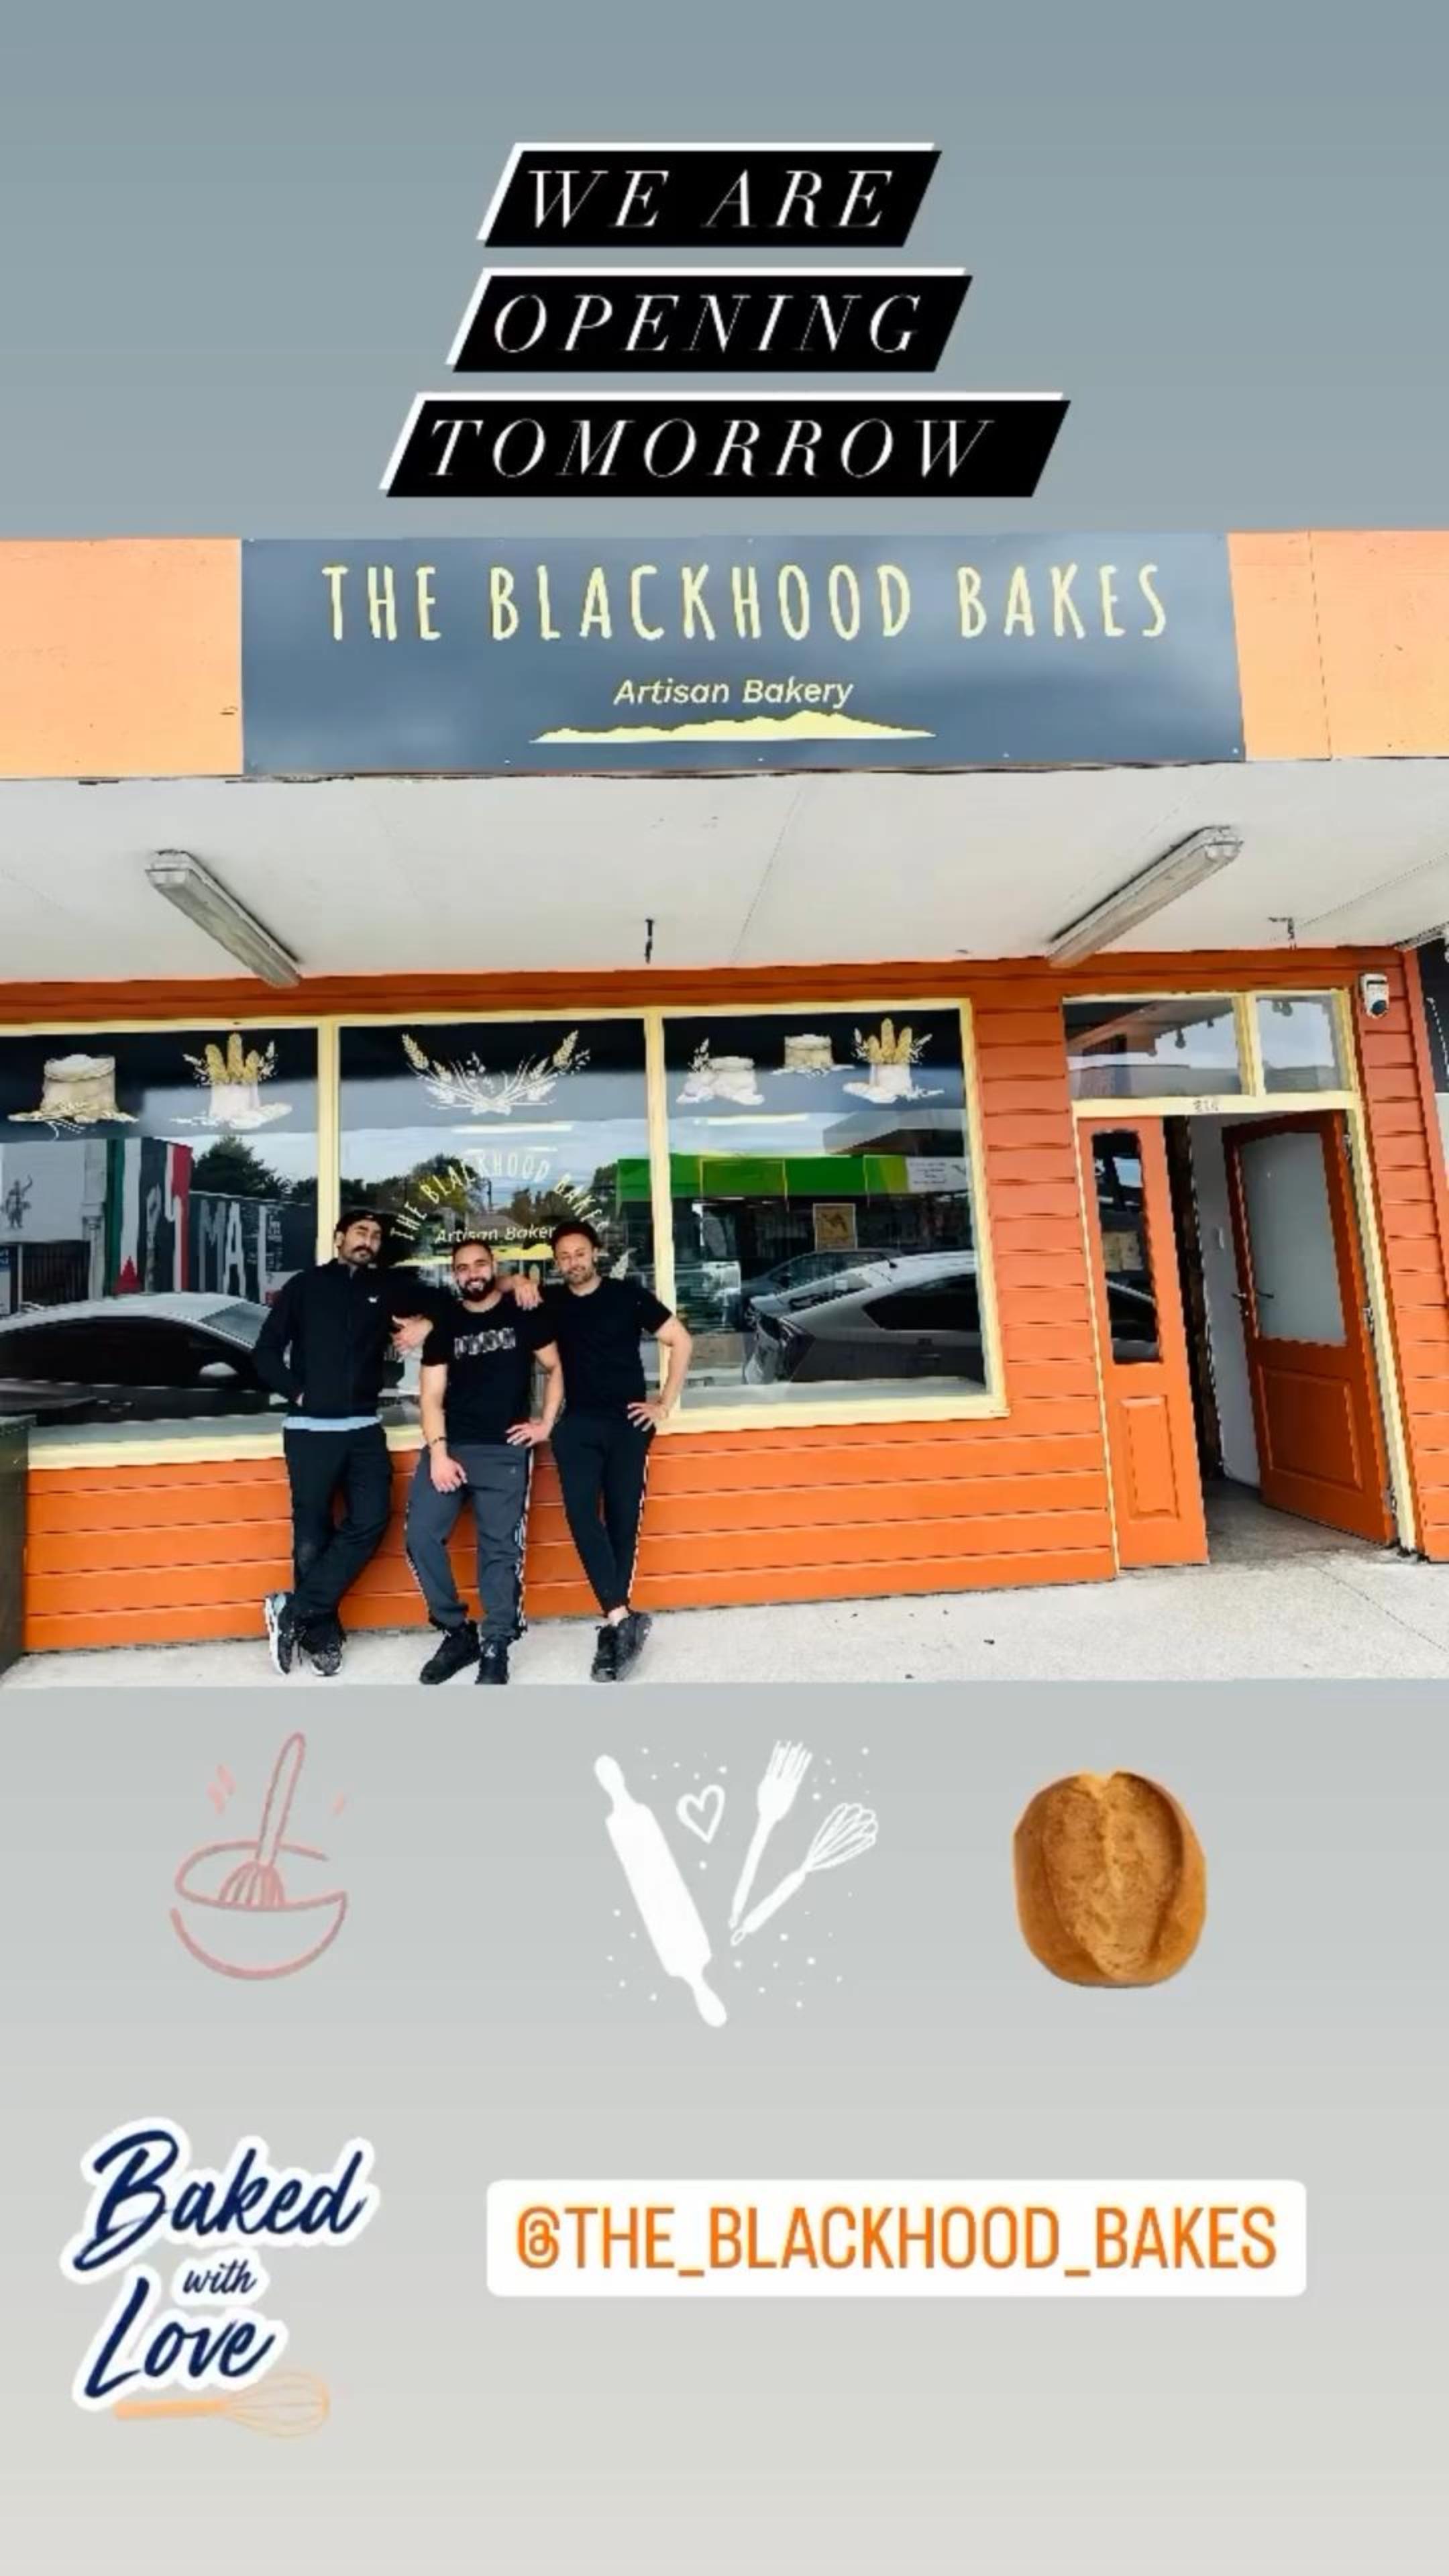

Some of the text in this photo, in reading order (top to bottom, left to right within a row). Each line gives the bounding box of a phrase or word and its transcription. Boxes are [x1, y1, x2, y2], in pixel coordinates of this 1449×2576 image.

[322, 563, 1169, 641] THE BLACKHOOD BAKES
[612, 676, 855, 709] Artisan Bakery
[389, 1201, 428, 1242] THE
[419, 1150, 551, 1205] BLACKHOOD
[434, 1224, 555, 1244] Artisan Baker
